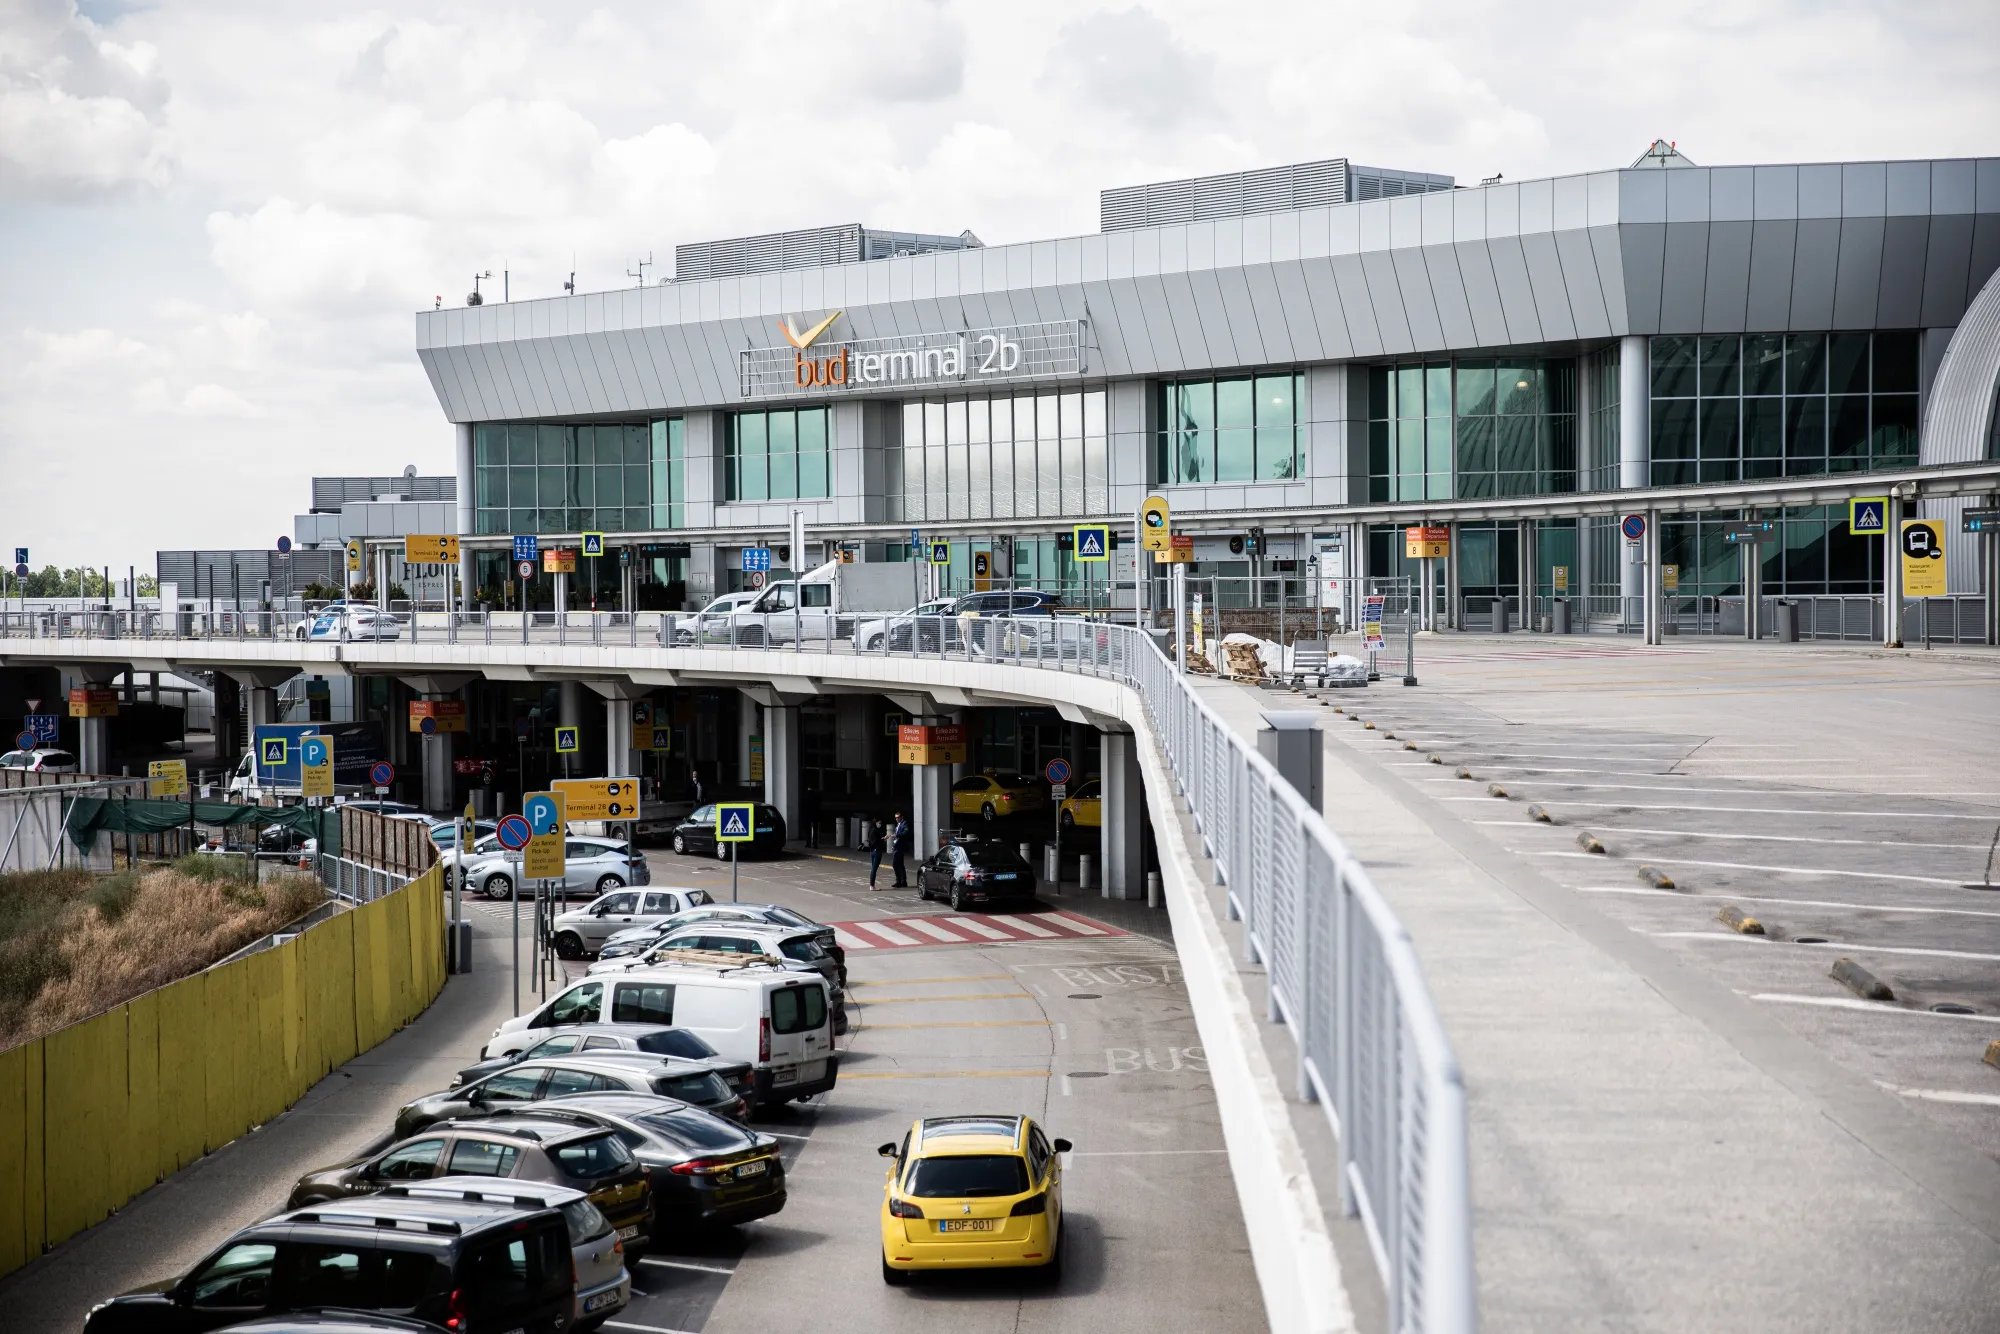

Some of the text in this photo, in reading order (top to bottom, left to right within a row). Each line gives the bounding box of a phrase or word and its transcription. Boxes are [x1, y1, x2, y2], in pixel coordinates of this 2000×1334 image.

[978, 334, 1021, 374] 2b
[913, 533, 918, 546] P
[1434, 546, 1440, 554] 8
[309, 746, 318, 760] P
[910, 752, 914, 760] 8
[945, 752, 950, 760] 8
[534, 804, 547, 826] P
[1051, 965, 1157, 988] BUS
[1106, 1046, 1209, 1074] BUS
[740, 1161, 765, 1176] RUW-280
[947, 1220, 990, 1231] EDF-001
